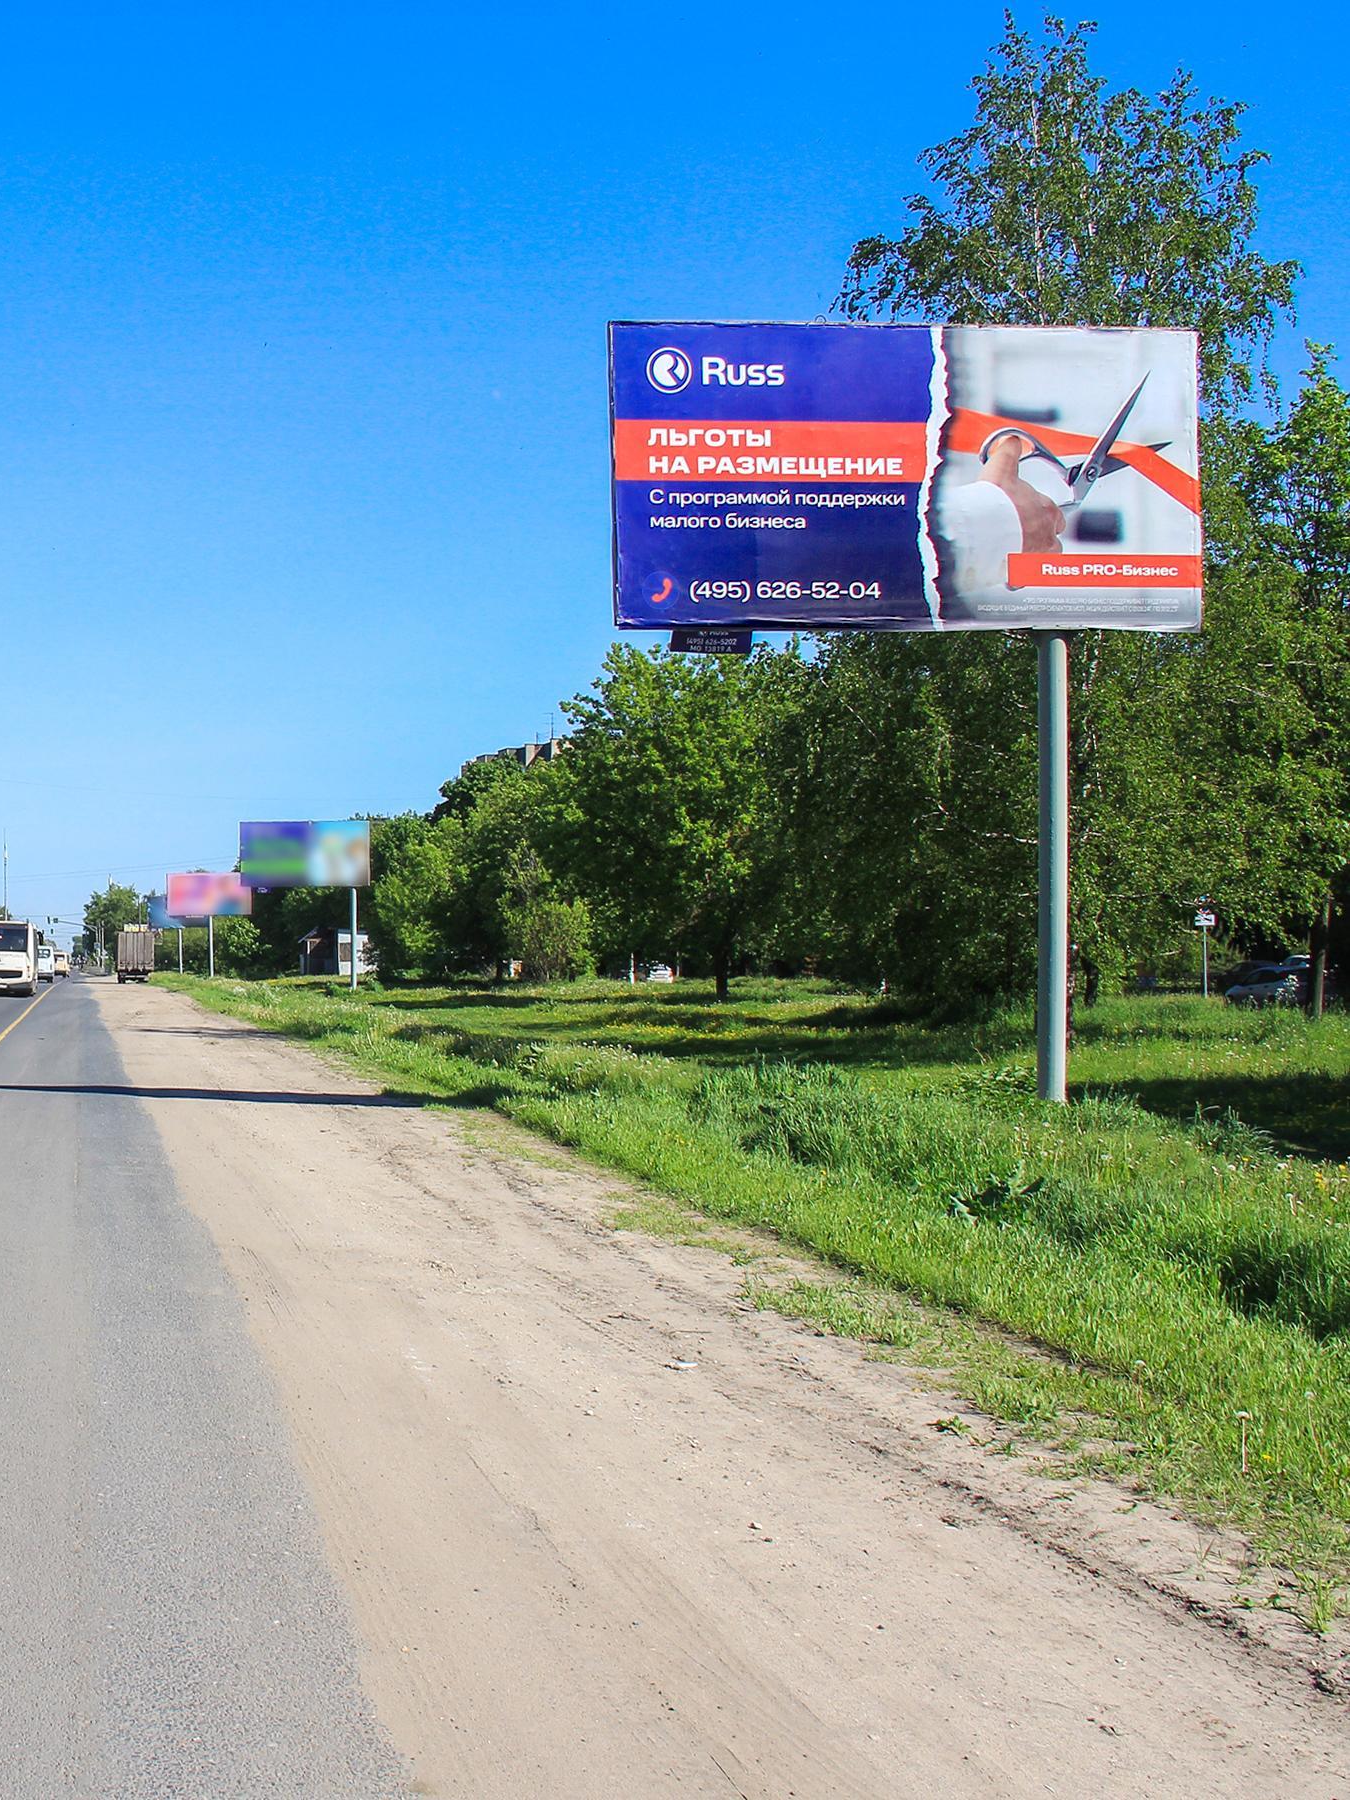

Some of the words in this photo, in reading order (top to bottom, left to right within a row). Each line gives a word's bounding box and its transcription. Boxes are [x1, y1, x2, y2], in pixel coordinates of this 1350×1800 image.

[702, 356, 785, 386] Russ
[648, 428, 772, 447] ЛЬГОТЫ
[649, 456, 690, 474] НА
[698, 457, 904, 478] РАЗМЕЩЕНИЕ
[649, 489, 665, 504] С
[668, 490, 790, 508] программой
[795, 493, 905, 508] поддержки
[650, 517, 720, 529] малого
[725, 513, 806, 529] бизнеса
[1041, 563, 1081, 576] Russ
[1082, 563, 1179, 577] PRO-Бизнес
[689, 580, 751, 603] (495)
[756, 581, 881, 600] 626-52-04
